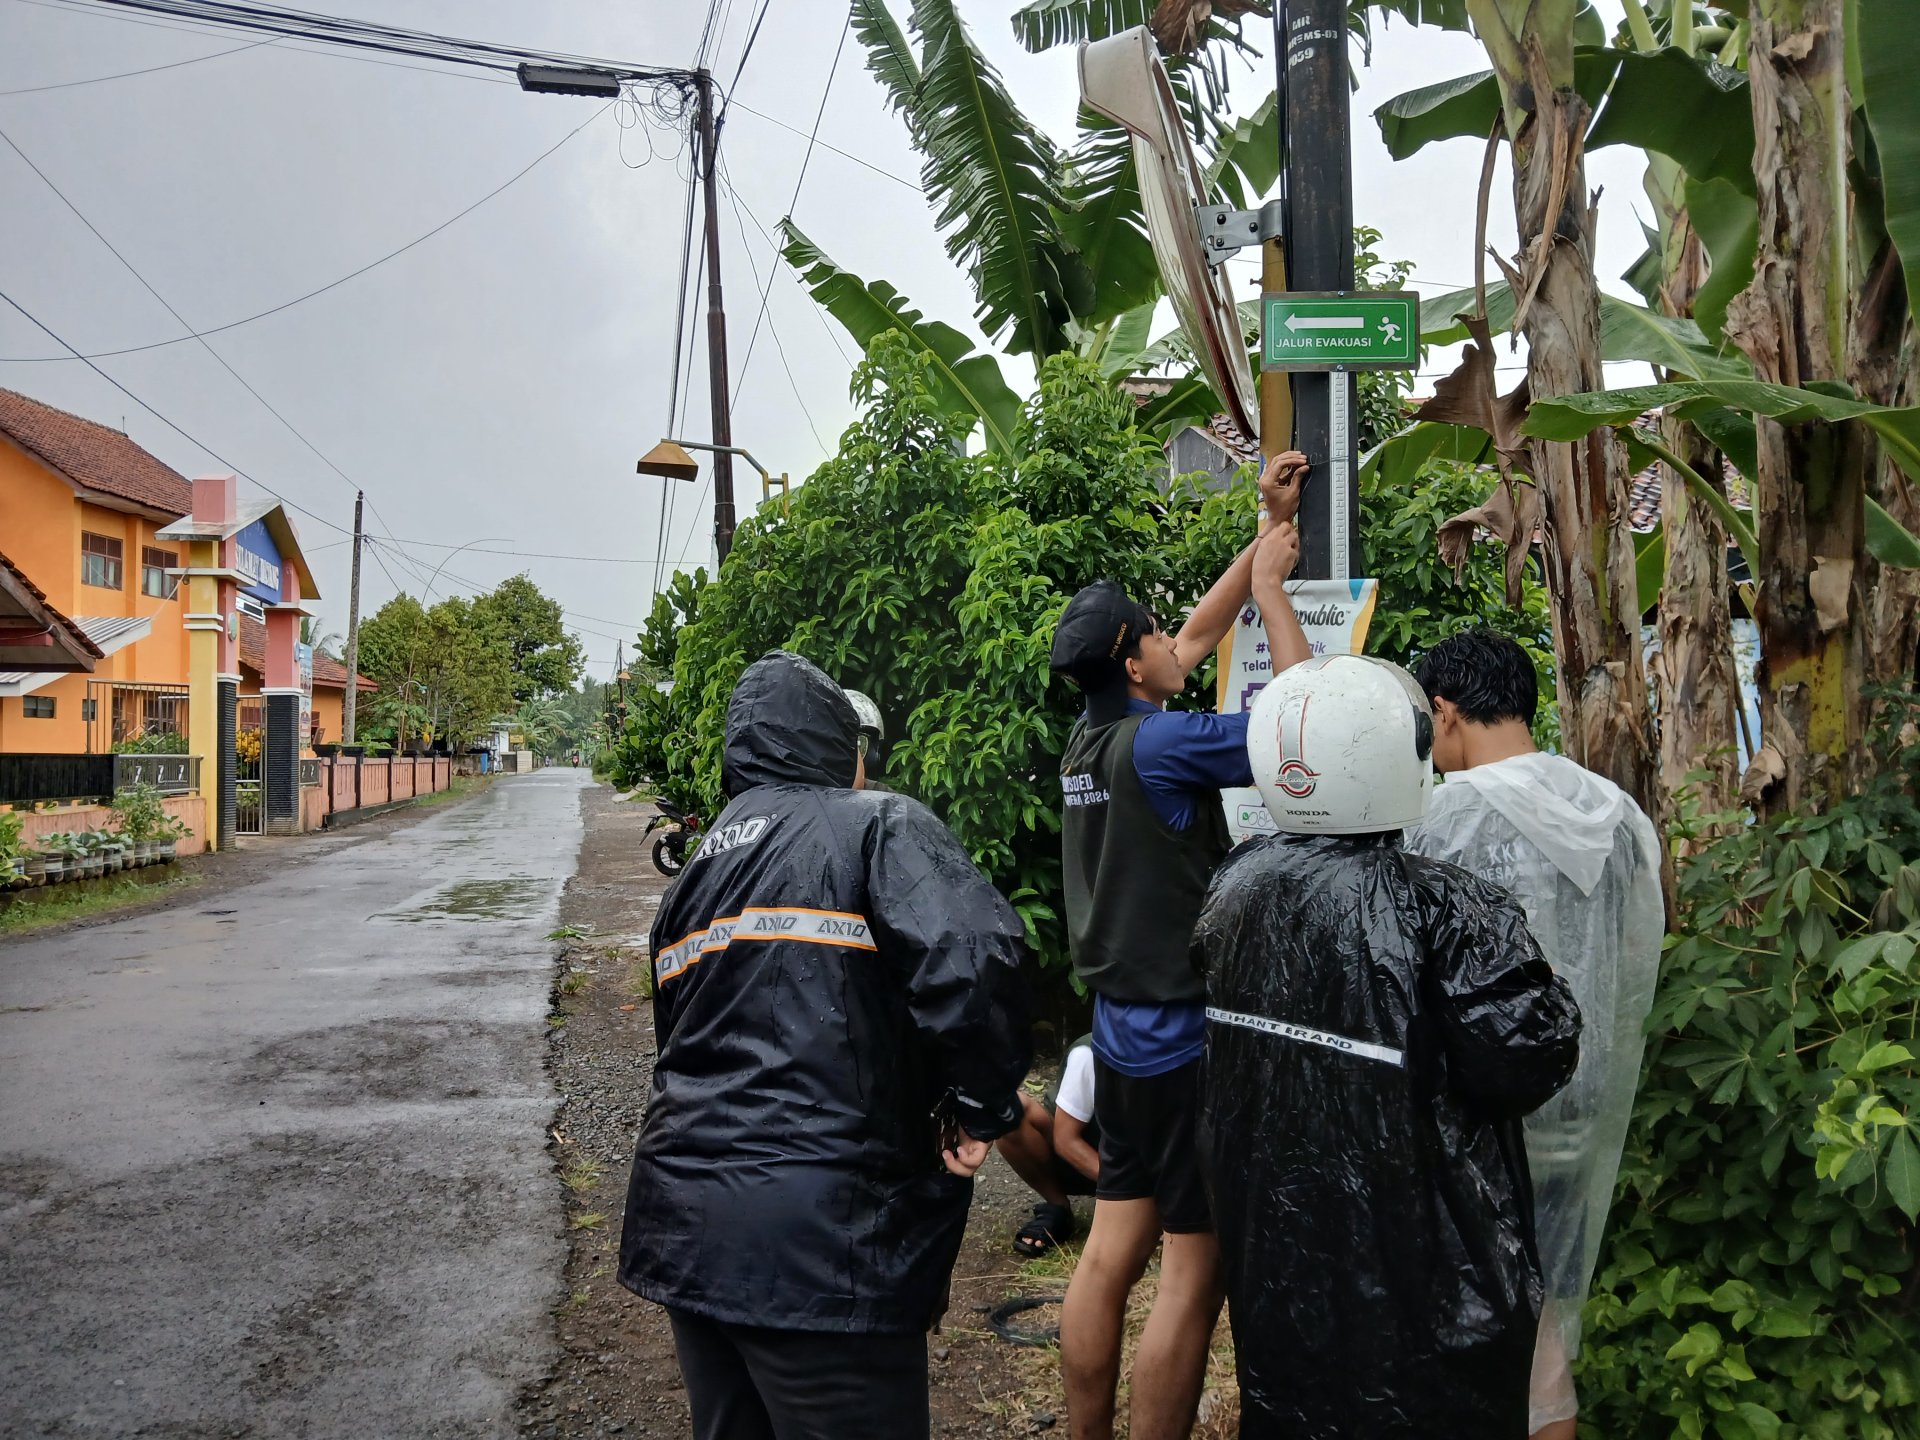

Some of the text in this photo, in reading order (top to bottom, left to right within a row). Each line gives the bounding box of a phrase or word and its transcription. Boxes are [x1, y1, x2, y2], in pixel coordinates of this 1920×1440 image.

[1276, 337, 1372, 348] JALUR EVAKUASI
[1084, 789, 1110, 805] 2026
[1285, 809, 1332, 817] HONDA
